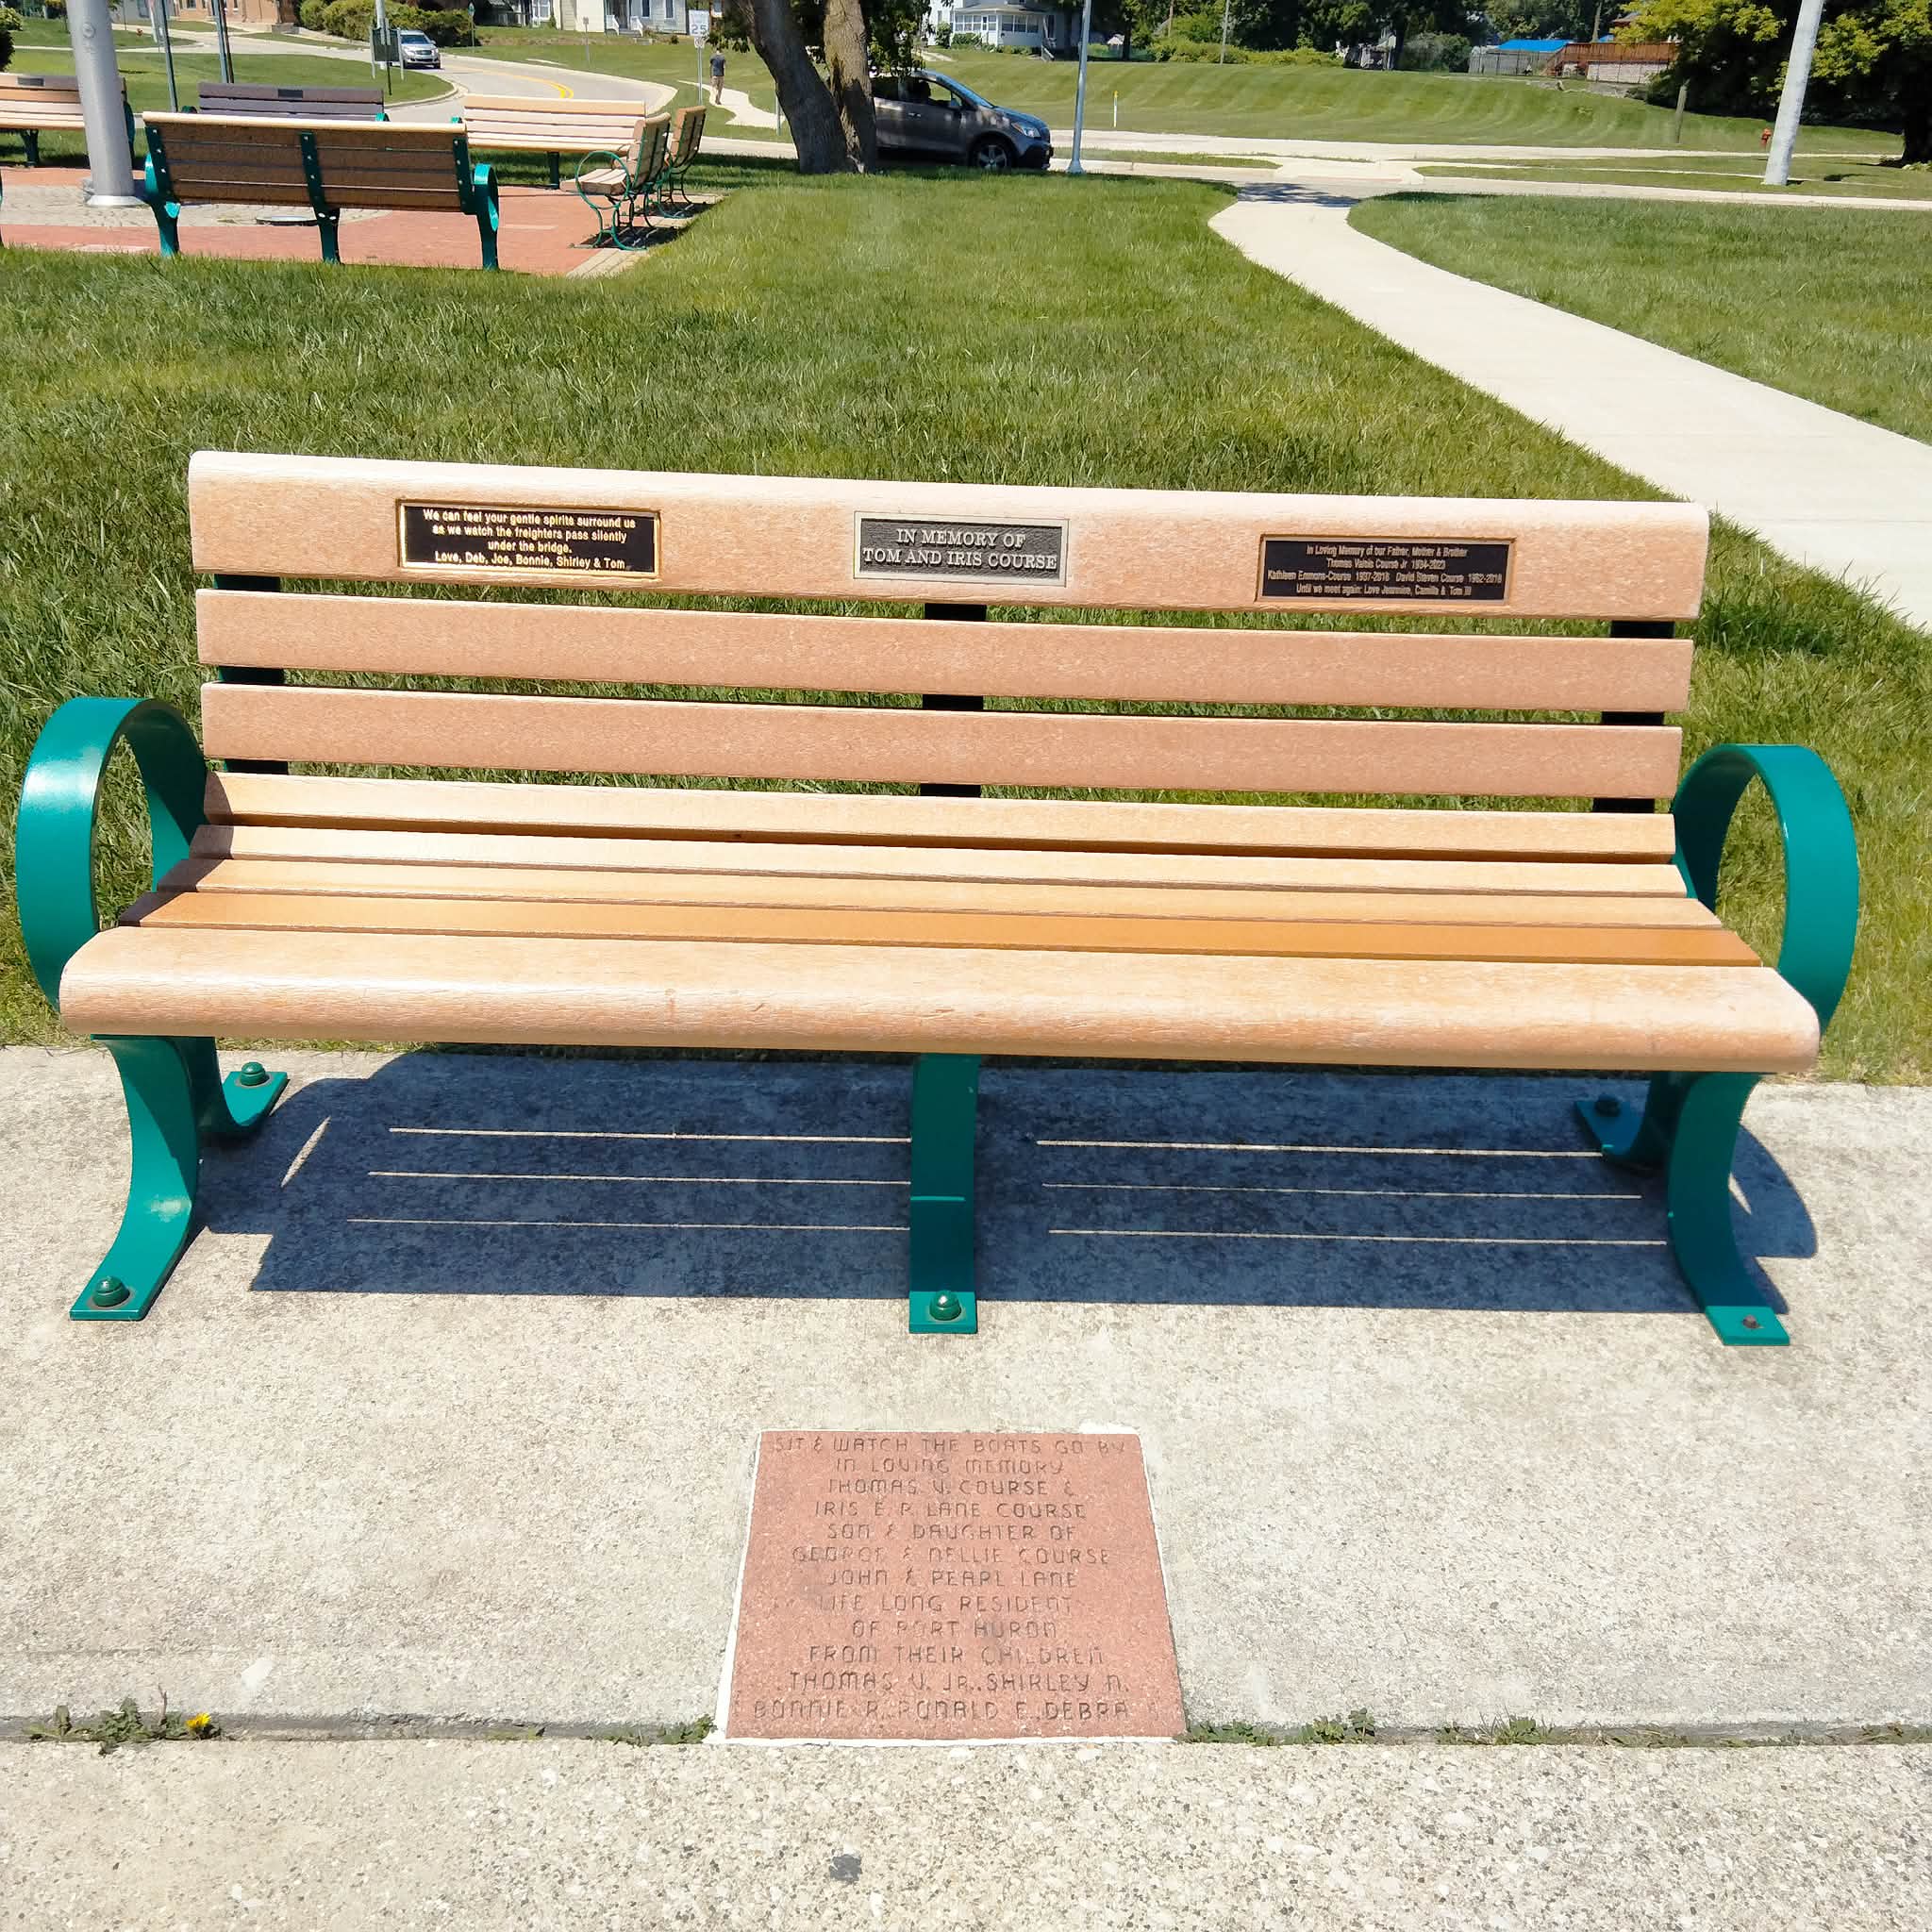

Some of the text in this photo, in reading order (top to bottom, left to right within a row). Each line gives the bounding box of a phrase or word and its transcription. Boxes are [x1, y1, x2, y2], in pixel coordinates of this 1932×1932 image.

[691, 25, 708, 35] 25
[423, 508, 636, 528] We can feel your gentle spirits surround us
[432, 525, 627, 543] as we watch the freighters pass silently
[896, 528, 1026, 548] IN MEMORY OF
[488, 540, 573, 555] under the bridge.
[1307, 544, 1314, 555] In
[1315, 545, 1338, 557] Loving
[1339, 545, 1365, 557] Memory
[1366, 545, 1374, 555] of
[435, 551, 625, 569] Love, Deb, Joe, Bonnie, Shirley & Tom
[862, 547, 1058, 570] TOM AND IRIS COURSE
[1326, 558, 1352, 568] Thomas
[1396, 572, 1414, 582] David
[775, 1436, 1125, 1455] SIT & WATCH THE BOATS GO BY
[837, 1457, 1063, 1474] IN LOVING MEMORY
[829, 1478, 917, 1494] THOMAS
[959, 1479, 1048, 1495] COURSE
[816, 1501, 858, 1517] IRIS
[927, 1502, 980, 1518] LANE
[996, 1503, 1086, 1519] COURSE
[827, 1524, 870, 1540] SON
[913, 1524, 1035, 1541] DAUGHTER
[1050, 1524, 1075, 1541] OF
[929, 1546, 1004, 1564] NELLIE
[1019, 1547, 1110, 1565] COURSE
[827, 1569, 888, 1586] JOHN
[932, 1570, 1005, 1587] PEARL
[1021, 1571, 1077, 1588] LANE
[820, 1593, 864, 1610] LIFE
[881, 1594, 942, 1612] LONG
[853, 1620, 1057, 1639] OF PORT HURON
[809, 1645, 1104, 1666] FROM THEIR CHILDREN
[790, 1671, 892, 1691] THOMAS
